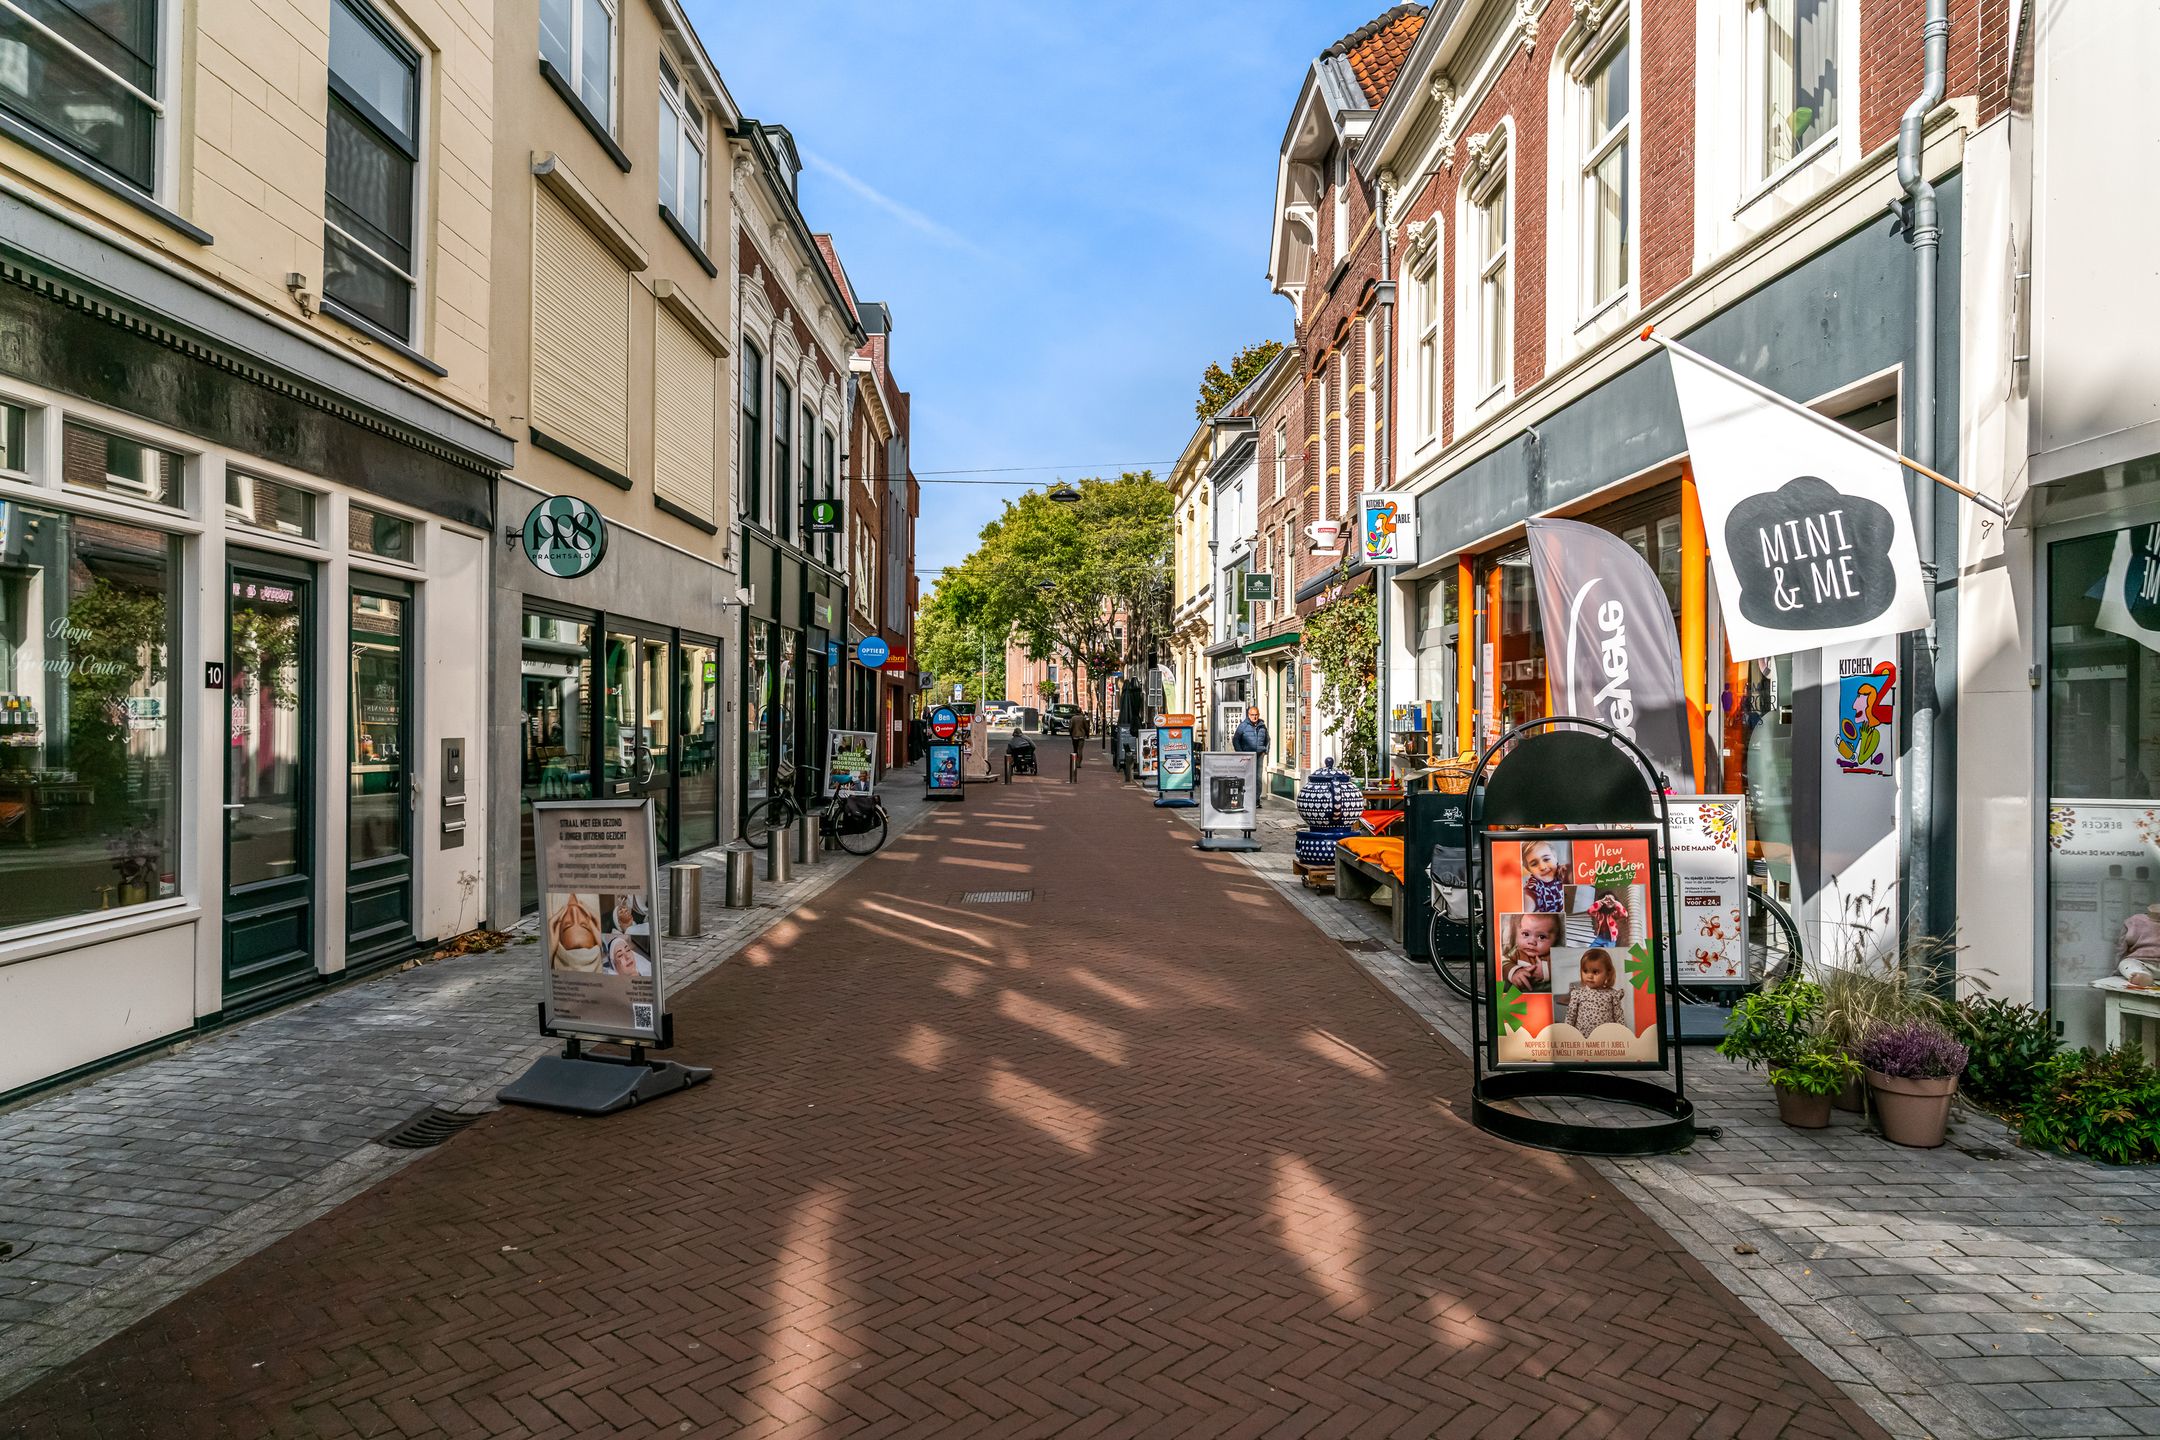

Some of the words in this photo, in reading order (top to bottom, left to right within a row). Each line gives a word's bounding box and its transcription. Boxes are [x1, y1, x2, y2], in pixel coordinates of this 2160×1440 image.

[1366, 499, 1385, 508] KITCHEN
[1395, 513, 1411, 524] TABLE
[1760, 510, 1853, 568] MINI
[1774, 567, 1804, 611] &
[1811, 556, 1860, 604] ME
[79, 654, 126, 675] Center
[1839, 658, 1872, 675] KITCHEN
[207, 667, 222, 684] 10
[1669, 817, 1695, 825] RGER
[606, 832, 627, 840] GEZICHT
[1594, 842, 1623, 858] New
[1578, 856, 1645, 878] Collection
[1625, 872, 1637, 880] 152
